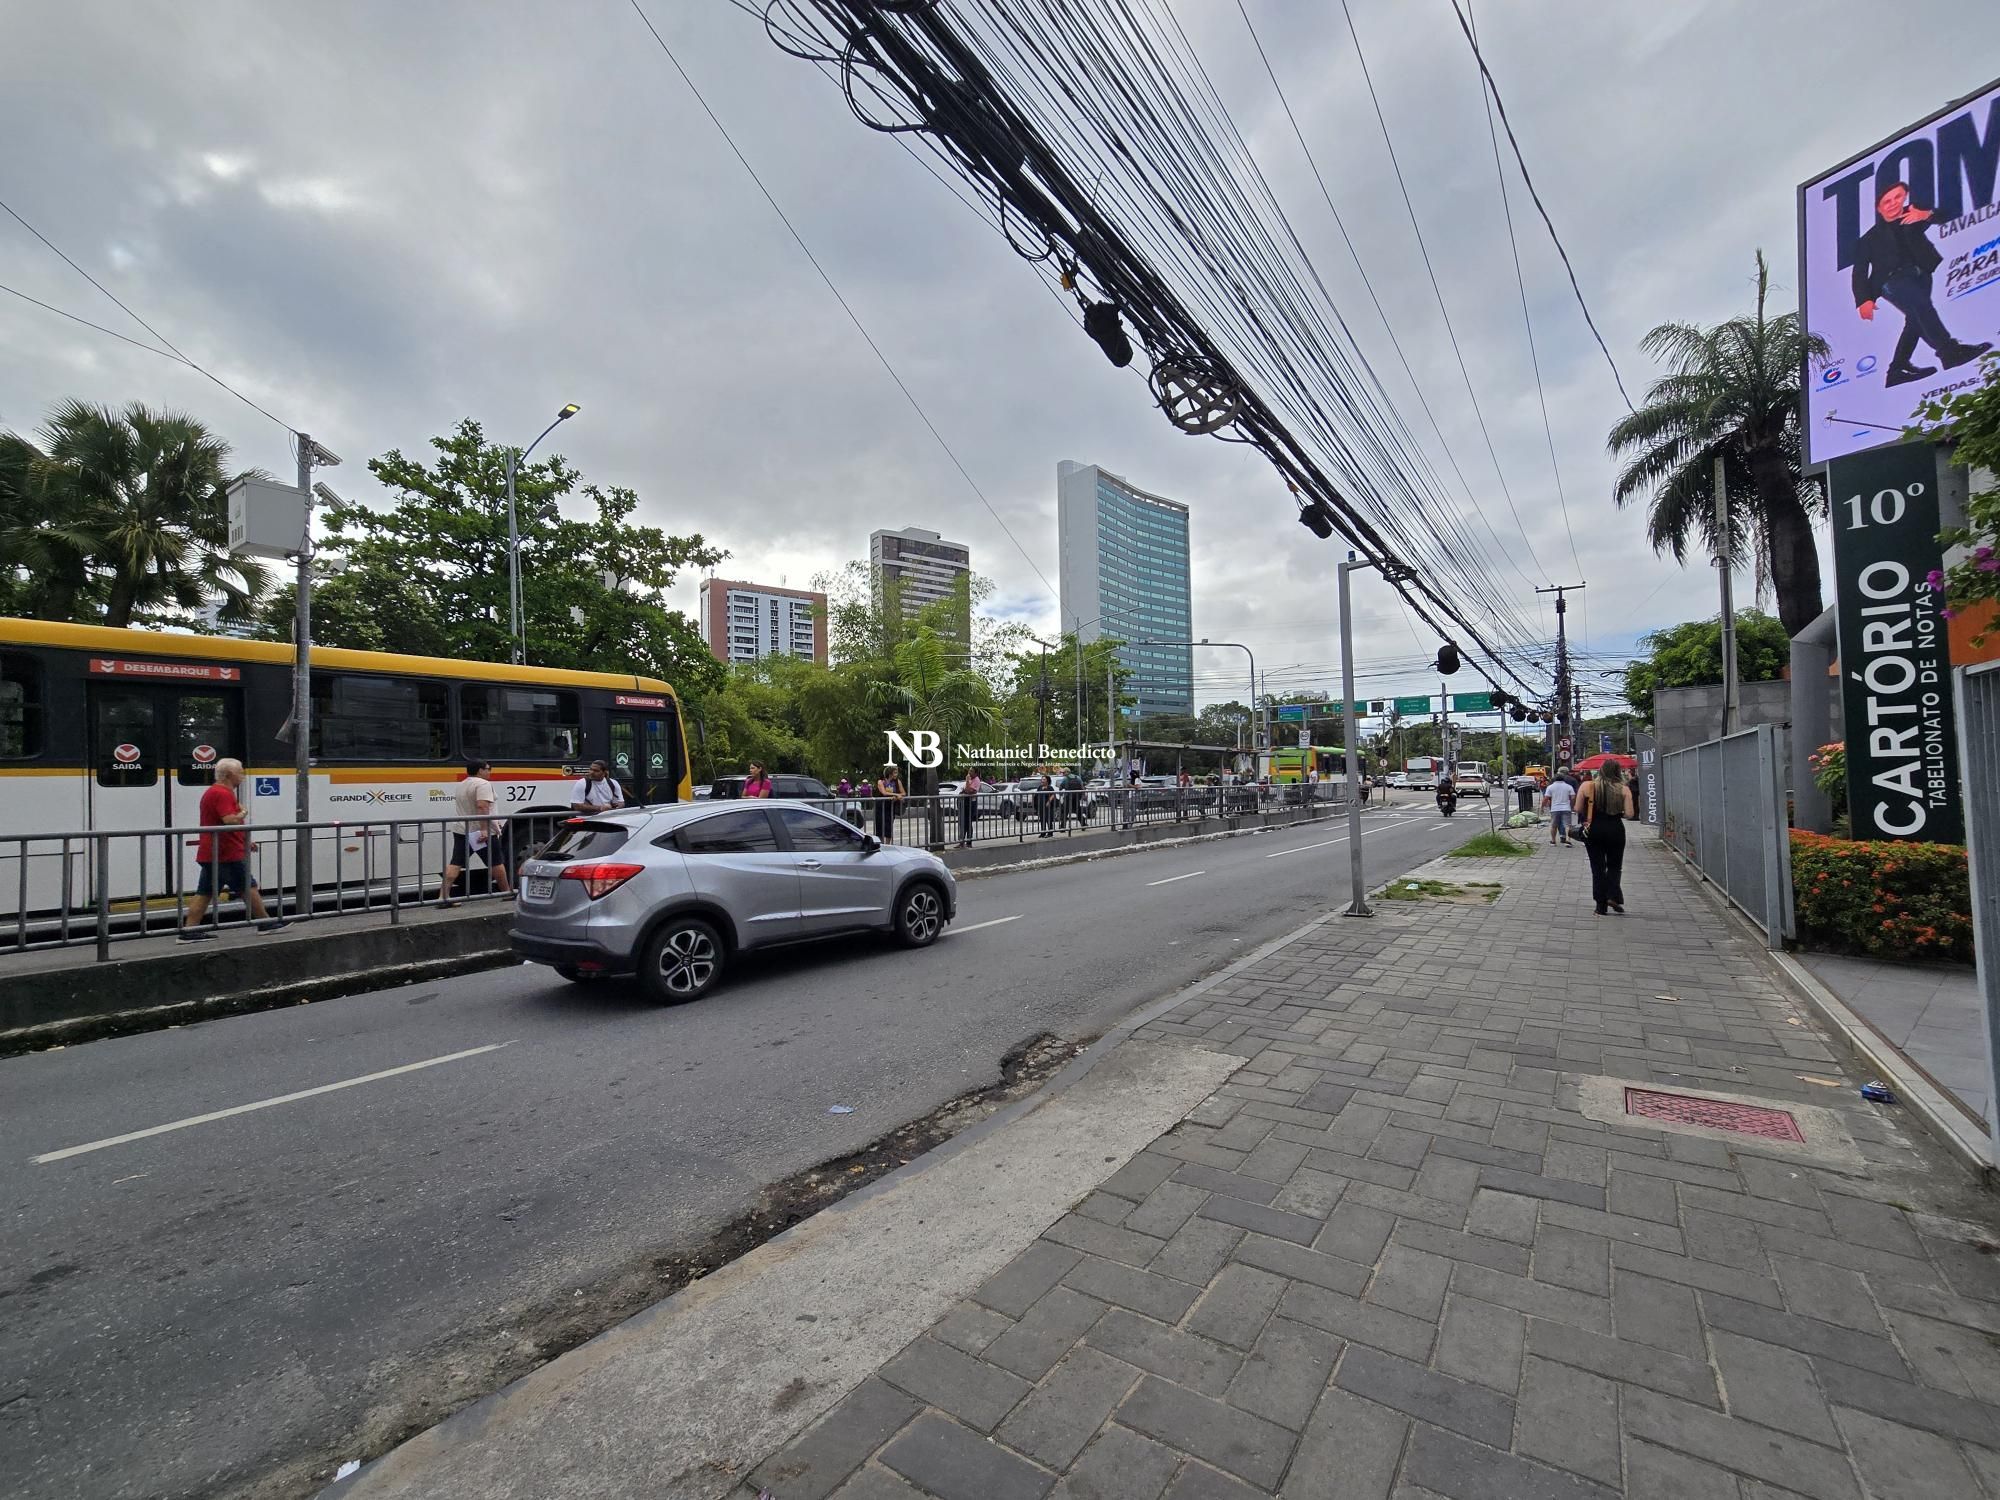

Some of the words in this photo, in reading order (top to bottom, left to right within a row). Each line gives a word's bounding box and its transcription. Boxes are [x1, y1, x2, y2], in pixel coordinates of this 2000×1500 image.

[1945, 250, 1998, 287] PARA
[1914, 581, 1936, 649] NOTAS
[123, 663, 210, 676] DESEMBARQUE
[1920, 659, 1938, 683] DE
[1852, 560, 1926, 836] CARTÓRIO
[1922, 692, 1947, 808] TABELIONATO
[384, 793, 413, 801] RECIFE
[506, 785, 537, 802] 327
[1647, 773, 1657, 823] CARTÓRIO
